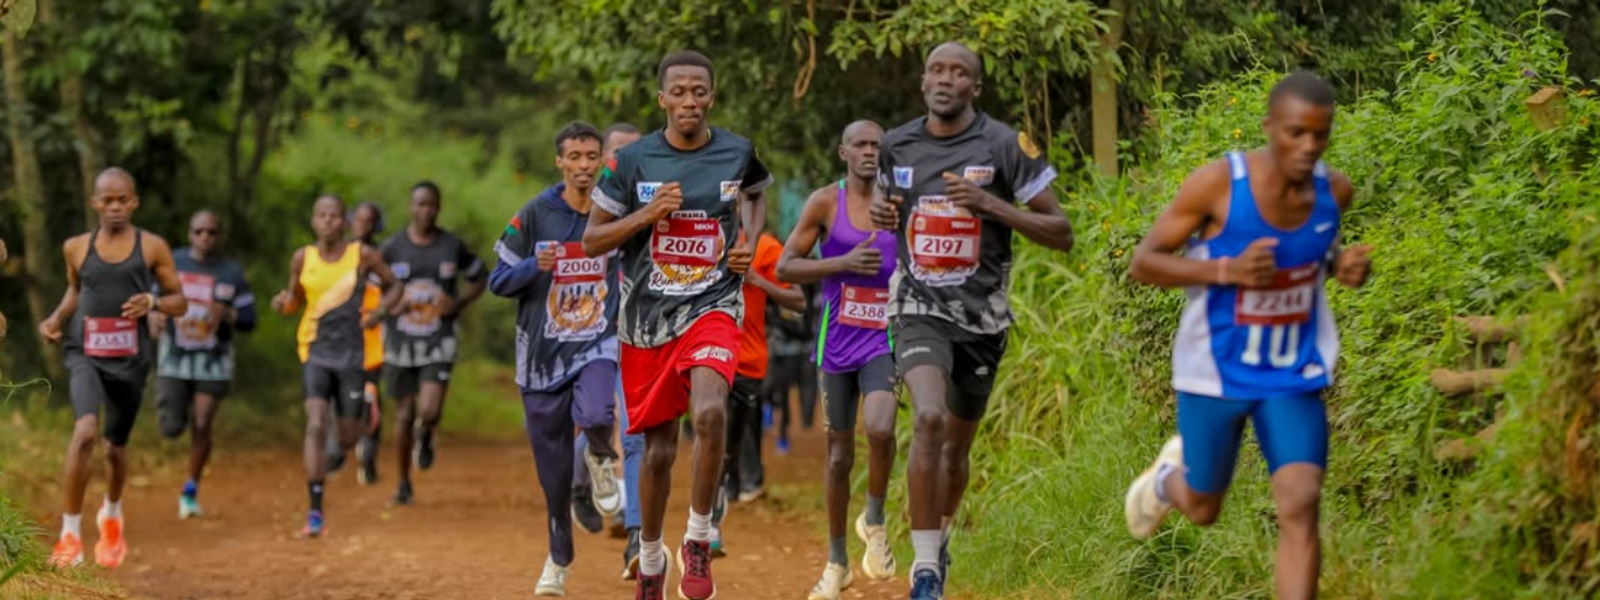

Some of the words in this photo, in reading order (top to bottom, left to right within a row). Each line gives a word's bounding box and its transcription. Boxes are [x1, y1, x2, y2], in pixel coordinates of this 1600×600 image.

[664, 238, 707, 254] 2076
[922, 238, 963, 254] 2197
[562, 260, 601, 273] 2006
[848, 304, 886, 319] 2388
